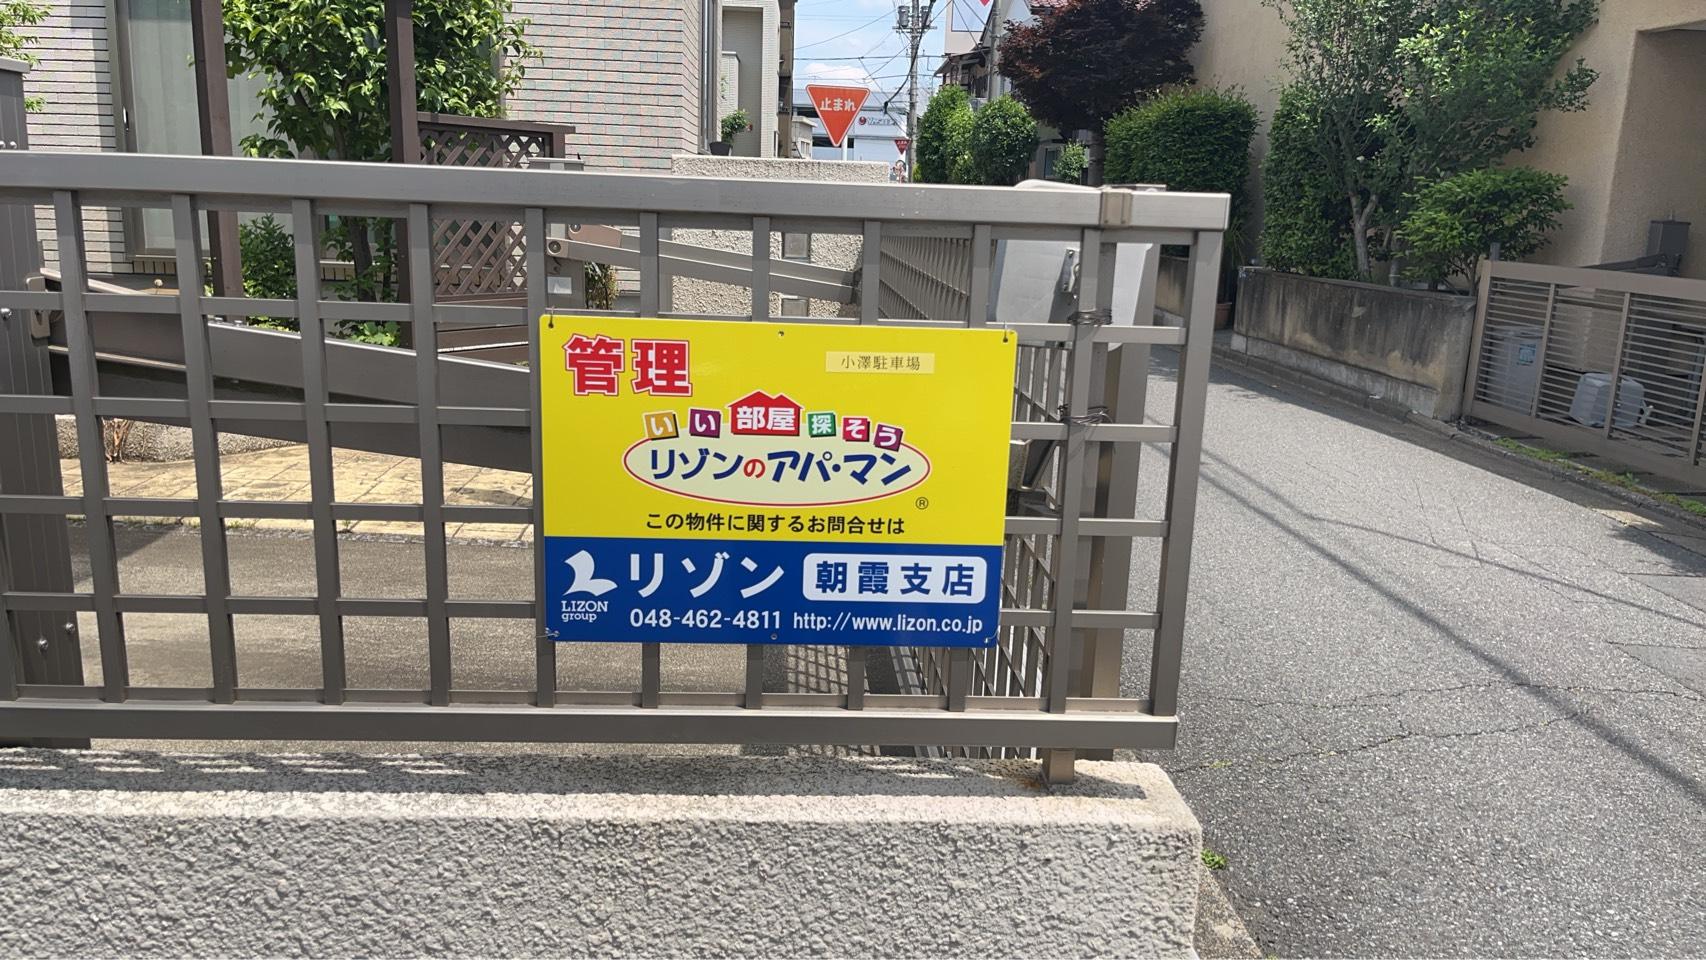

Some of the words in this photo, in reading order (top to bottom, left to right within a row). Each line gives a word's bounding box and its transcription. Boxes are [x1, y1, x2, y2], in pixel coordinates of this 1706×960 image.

[820, 97, 856, 112] 止まれ
[562, 333, 693, 397] 管理
[841, 355, 921, 371] 小澤駐車場
[648, 404, 900, 448] いい部屋探そう
[645, 512, 905, 534] この物件に関するお問合せは
[630, 551, 785, 599] リゾン
[815, 561, 975, 597] 朝霞支店
[561, 600, 608, 613] LIZON
[561, 613, 597, 623] group
[630, 608, 781, 629] 048-462-4811
[793, 612, 983, 634] http://www.lizon.co.jp
